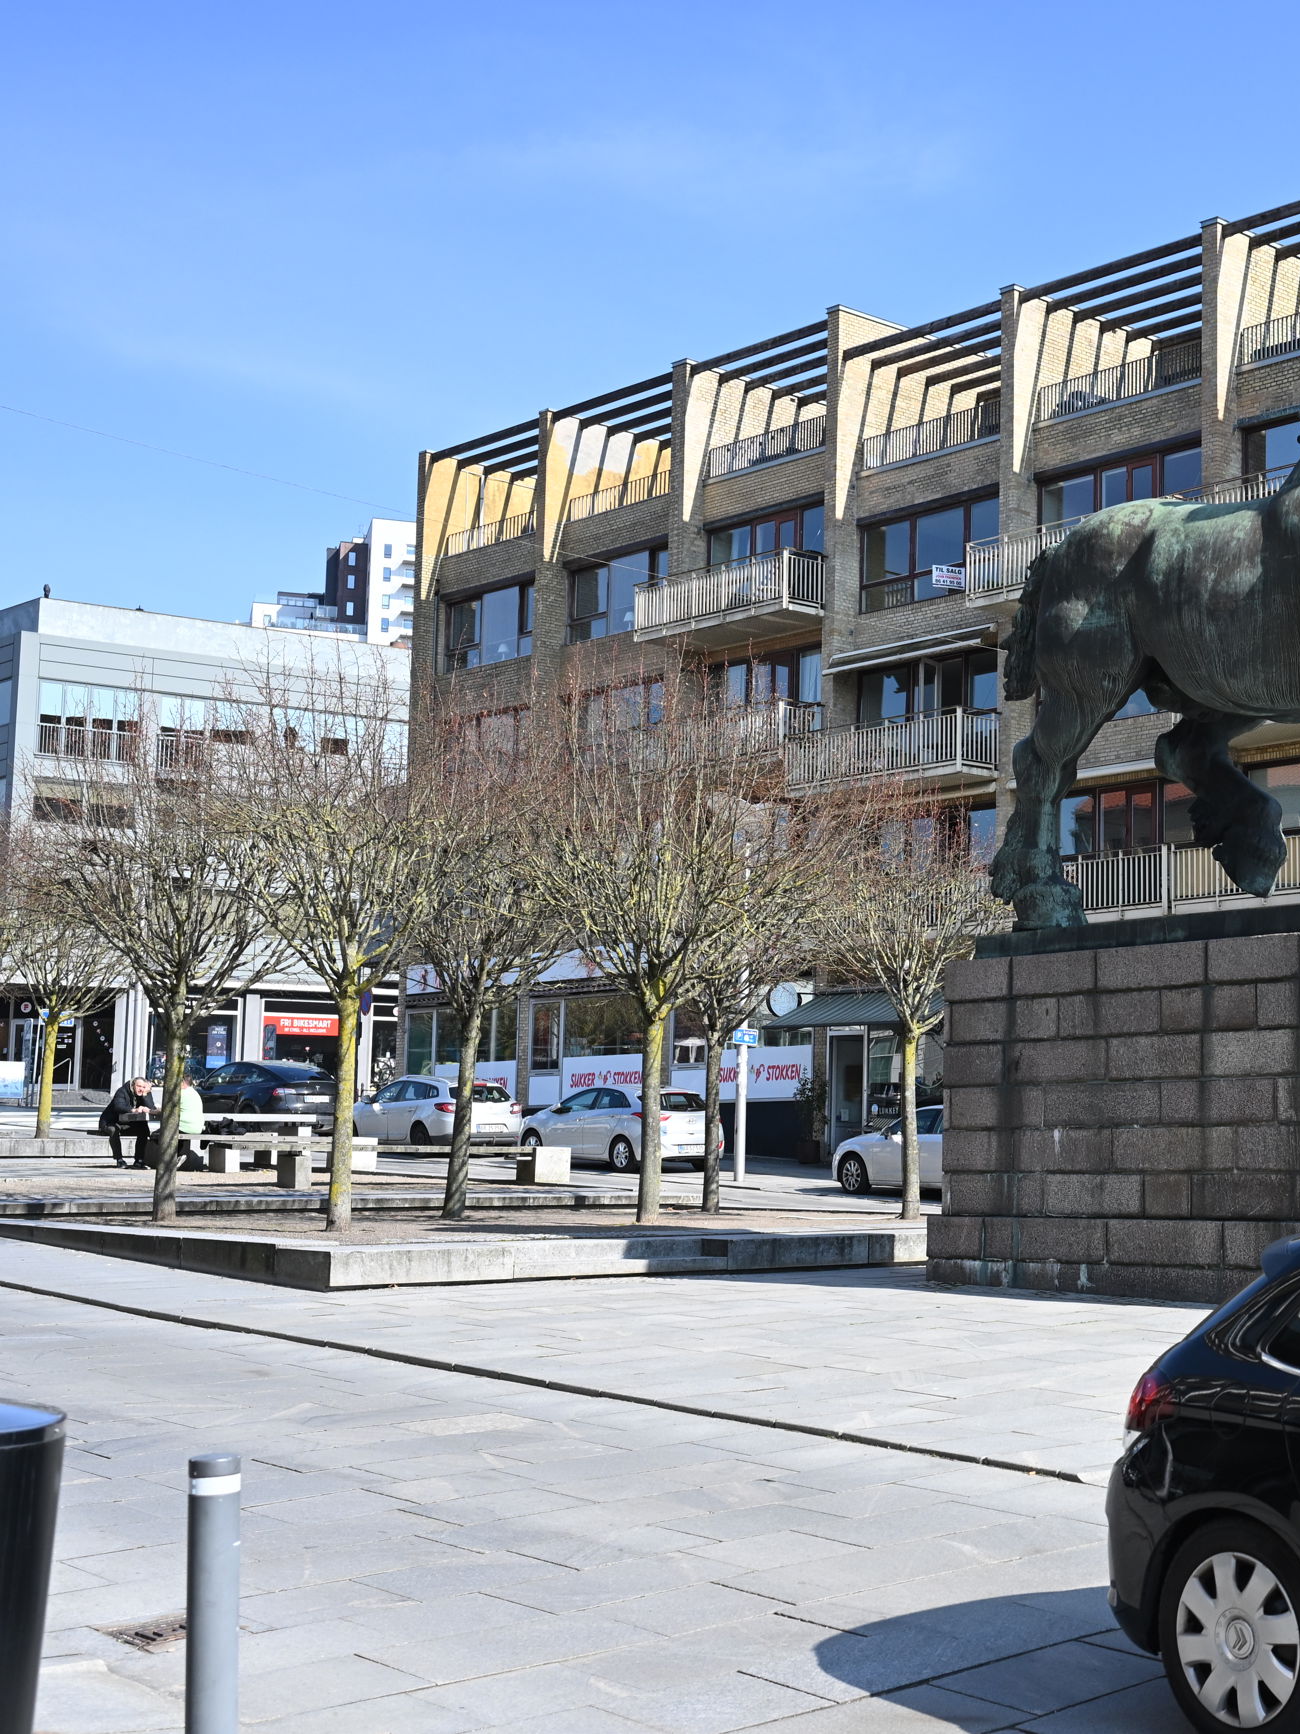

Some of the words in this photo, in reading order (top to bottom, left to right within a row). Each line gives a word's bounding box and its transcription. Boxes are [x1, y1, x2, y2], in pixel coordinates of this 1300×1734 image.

[280, 1019, 291, 1027] FRI
[293, 1019, 331, 1028] BIKESMART
[570, 1072, 596, 1088] SUKKER
[719, 1067, 737, 1083] SUKK
[766, 1064, 801, 1081] STOKKEN
